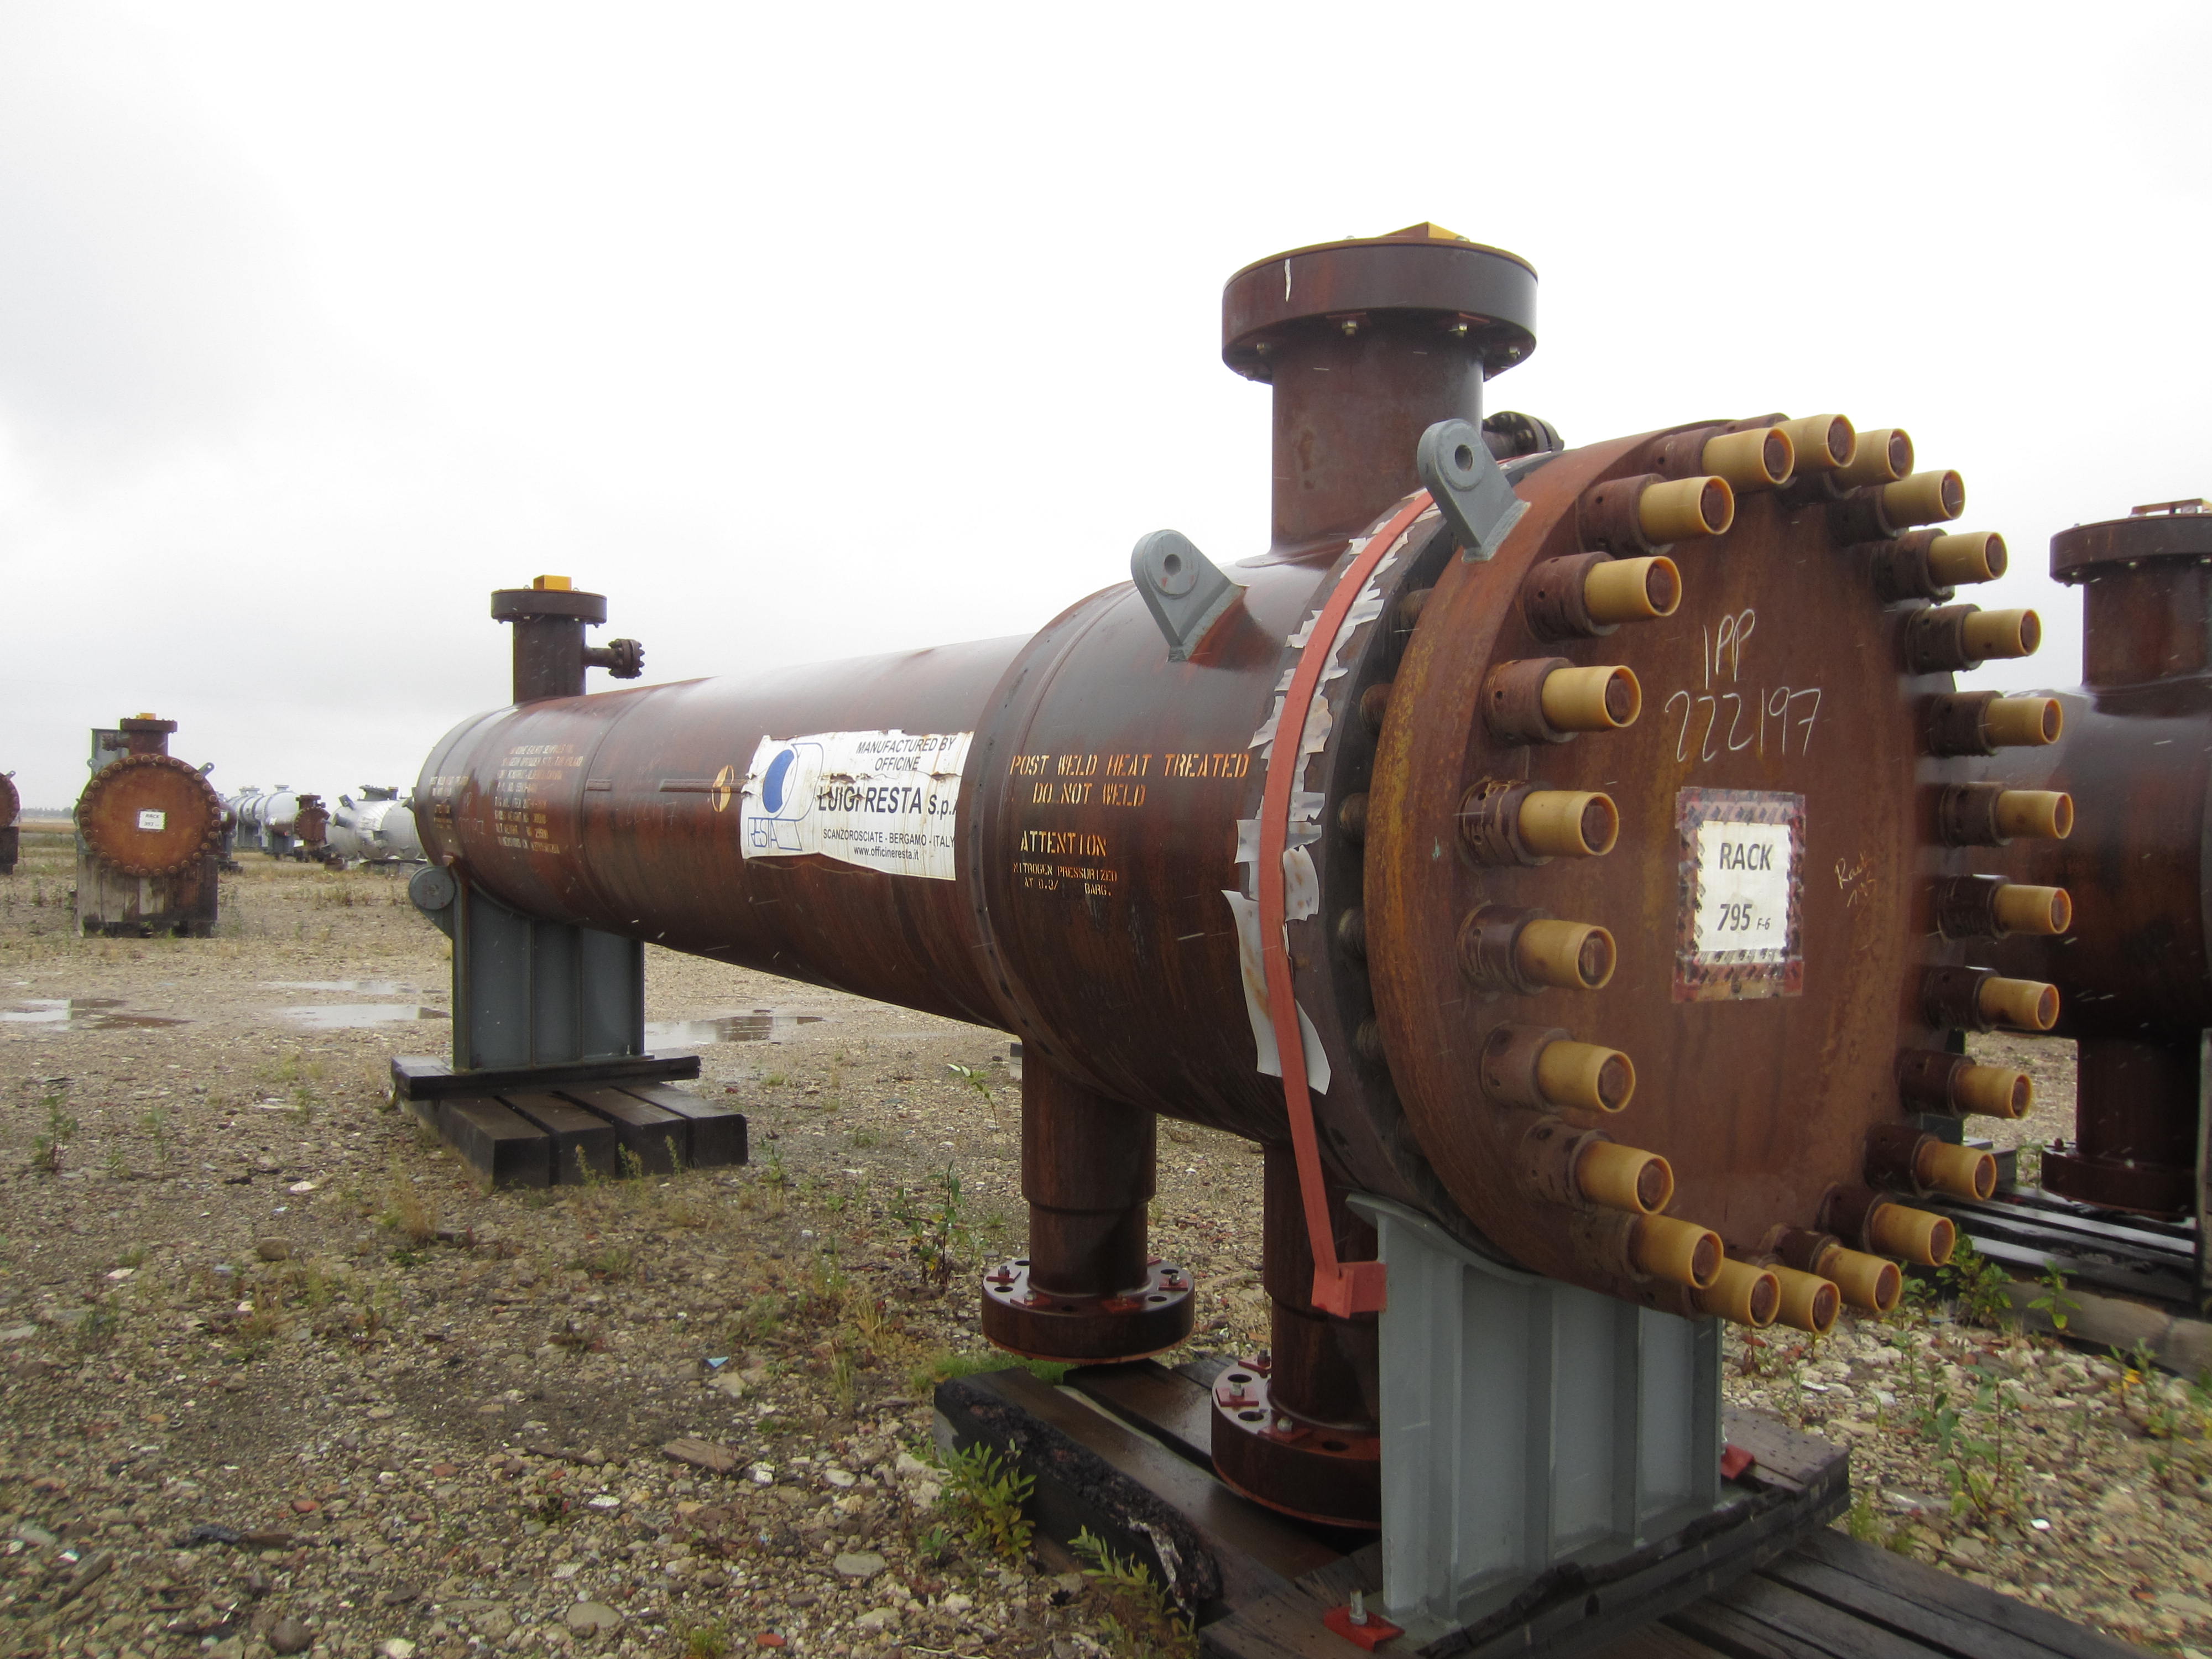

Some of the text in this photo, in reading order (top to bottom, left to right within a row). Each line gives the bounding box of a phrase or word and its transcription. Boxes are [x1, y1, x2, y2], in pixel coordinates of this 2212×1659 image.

[1665, 687, 1822, 762] 222197
[855, 736, 957, 754] MANUFACTURED BY
[875, 756, 921, 771] OFFICINE
[1010, 754, 1251, 778] POST WELD HEAT TREATED
[818, 785, 860, 812] LUIGI
[864, 786, 922, 815] RESTA
[1033, 782, 1147, 806] DO NOT WELD
[823, 828, 883, 843] SCANZOROSCIATE
[889, 832, 927, 846] BERGAMO
[933, 835, 956, 848] ITALY
[1020, 830, 1107, 857] ATTENTION
[854, 846, 920, 860] www.officineresta.it
[1719, 842, 1773, 871] RACK
[1013, 862, 1117, 881] NITROGEN PRESSURIZED
[1024, 877, 1034, 888] AT
[1717, 903, 1771, 931] 795 F-6
